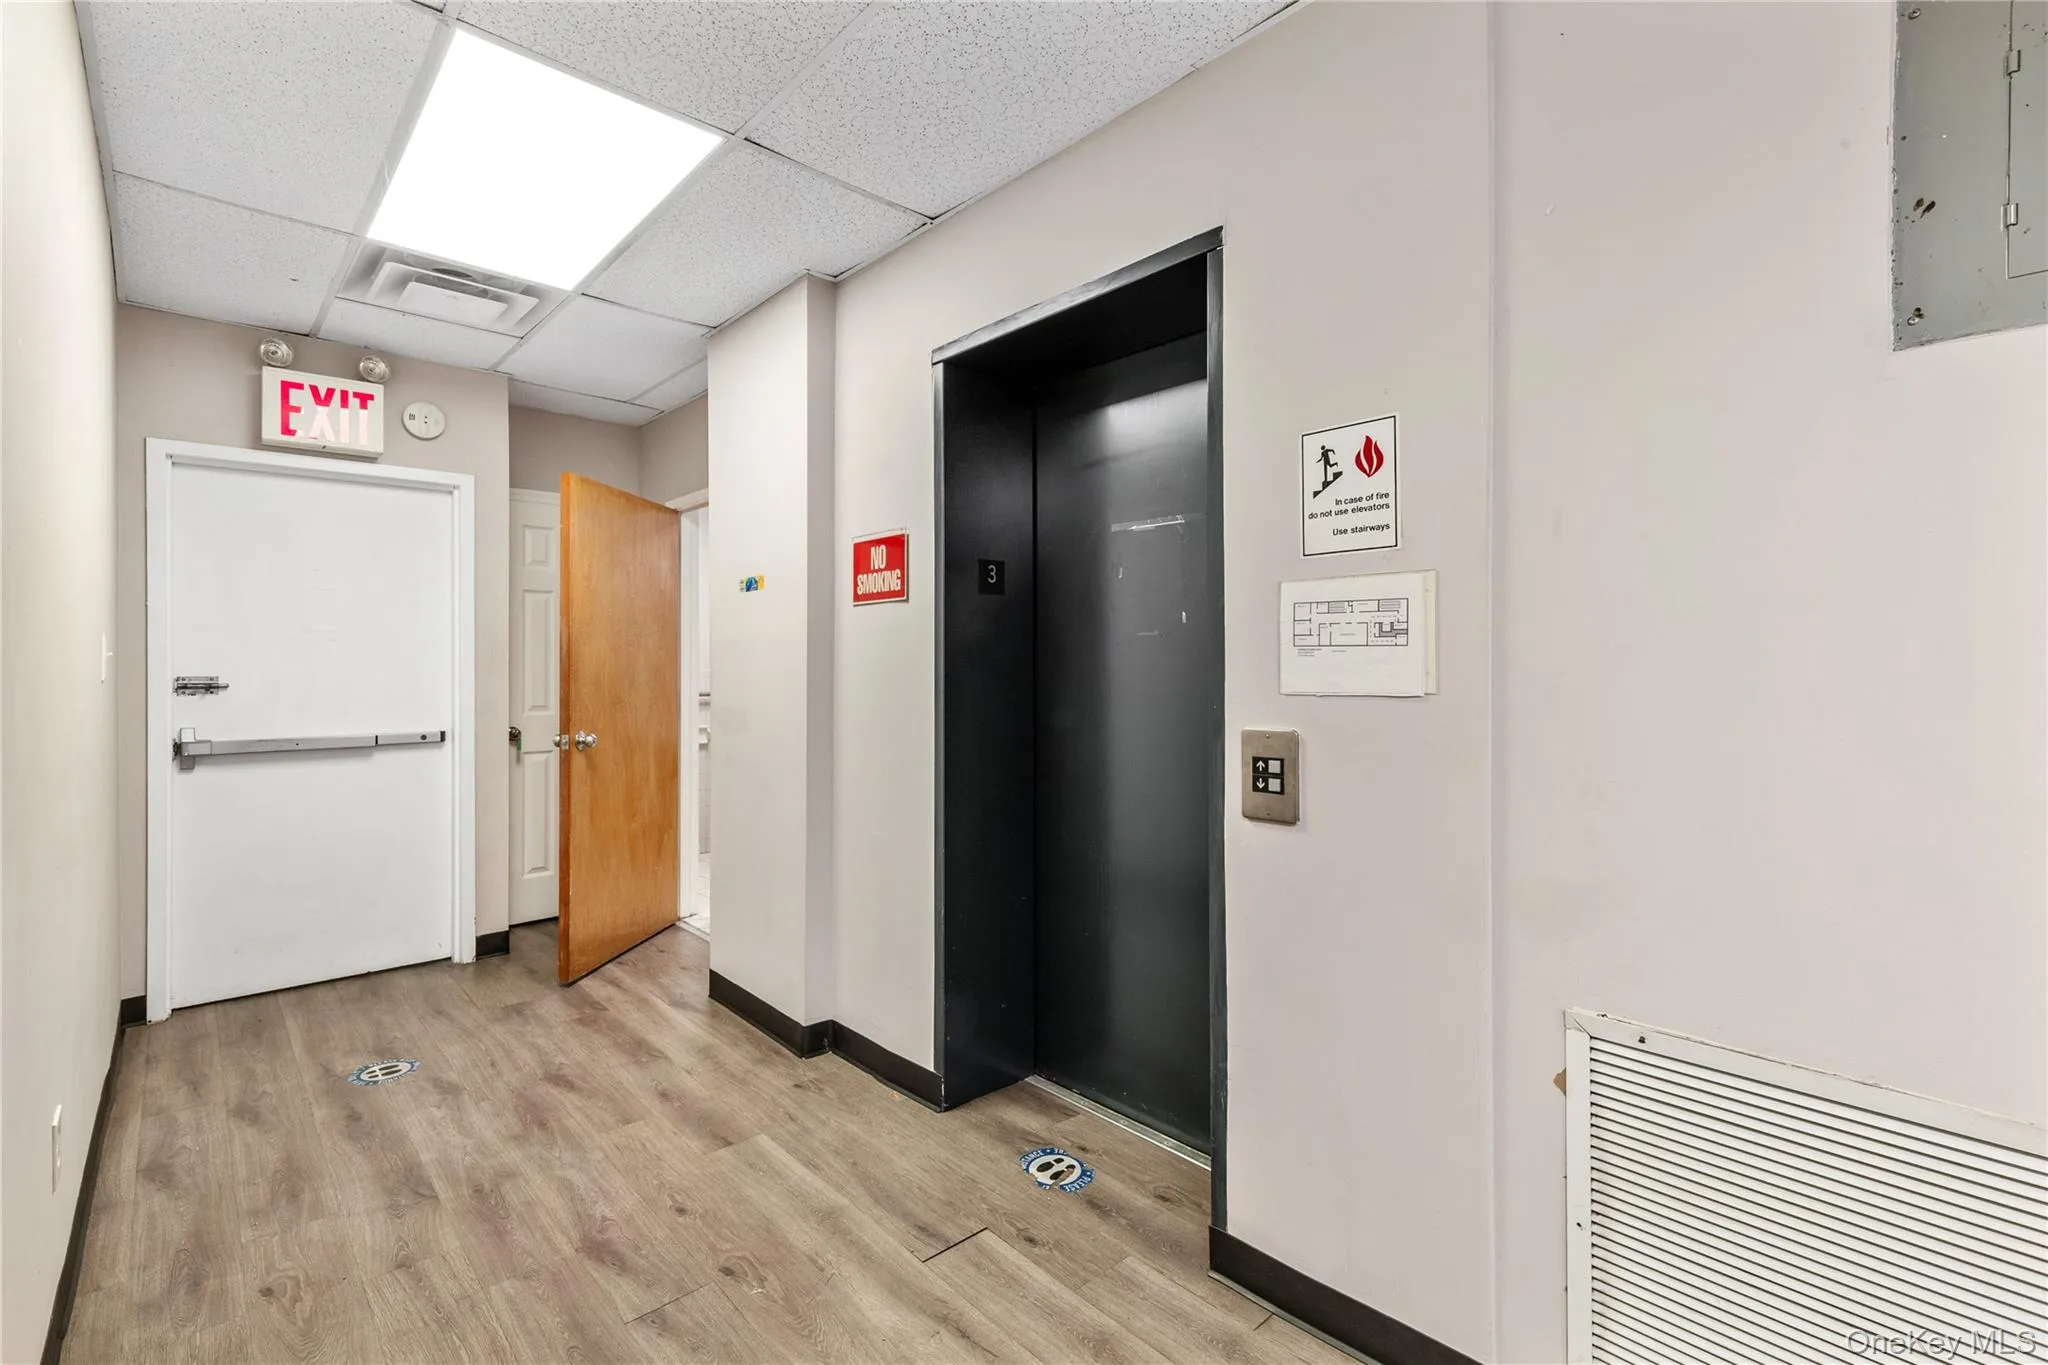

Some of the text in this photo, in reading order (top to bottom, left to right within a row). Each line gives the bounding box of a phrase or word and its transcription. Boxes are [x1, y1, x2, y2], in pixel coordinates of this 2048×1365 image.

[280, 379, 375, 446] EXIT
[1335, 491, 1390, 506] In case of fire
[1308, 502, 1390, 520] do not use elevators
[1332, 522, 1390, 536] Use stairways
[870, 544, 887, 570] NO
[857, 569, 901, 595] SMOKING
[987, 564, 997, 583] 3
